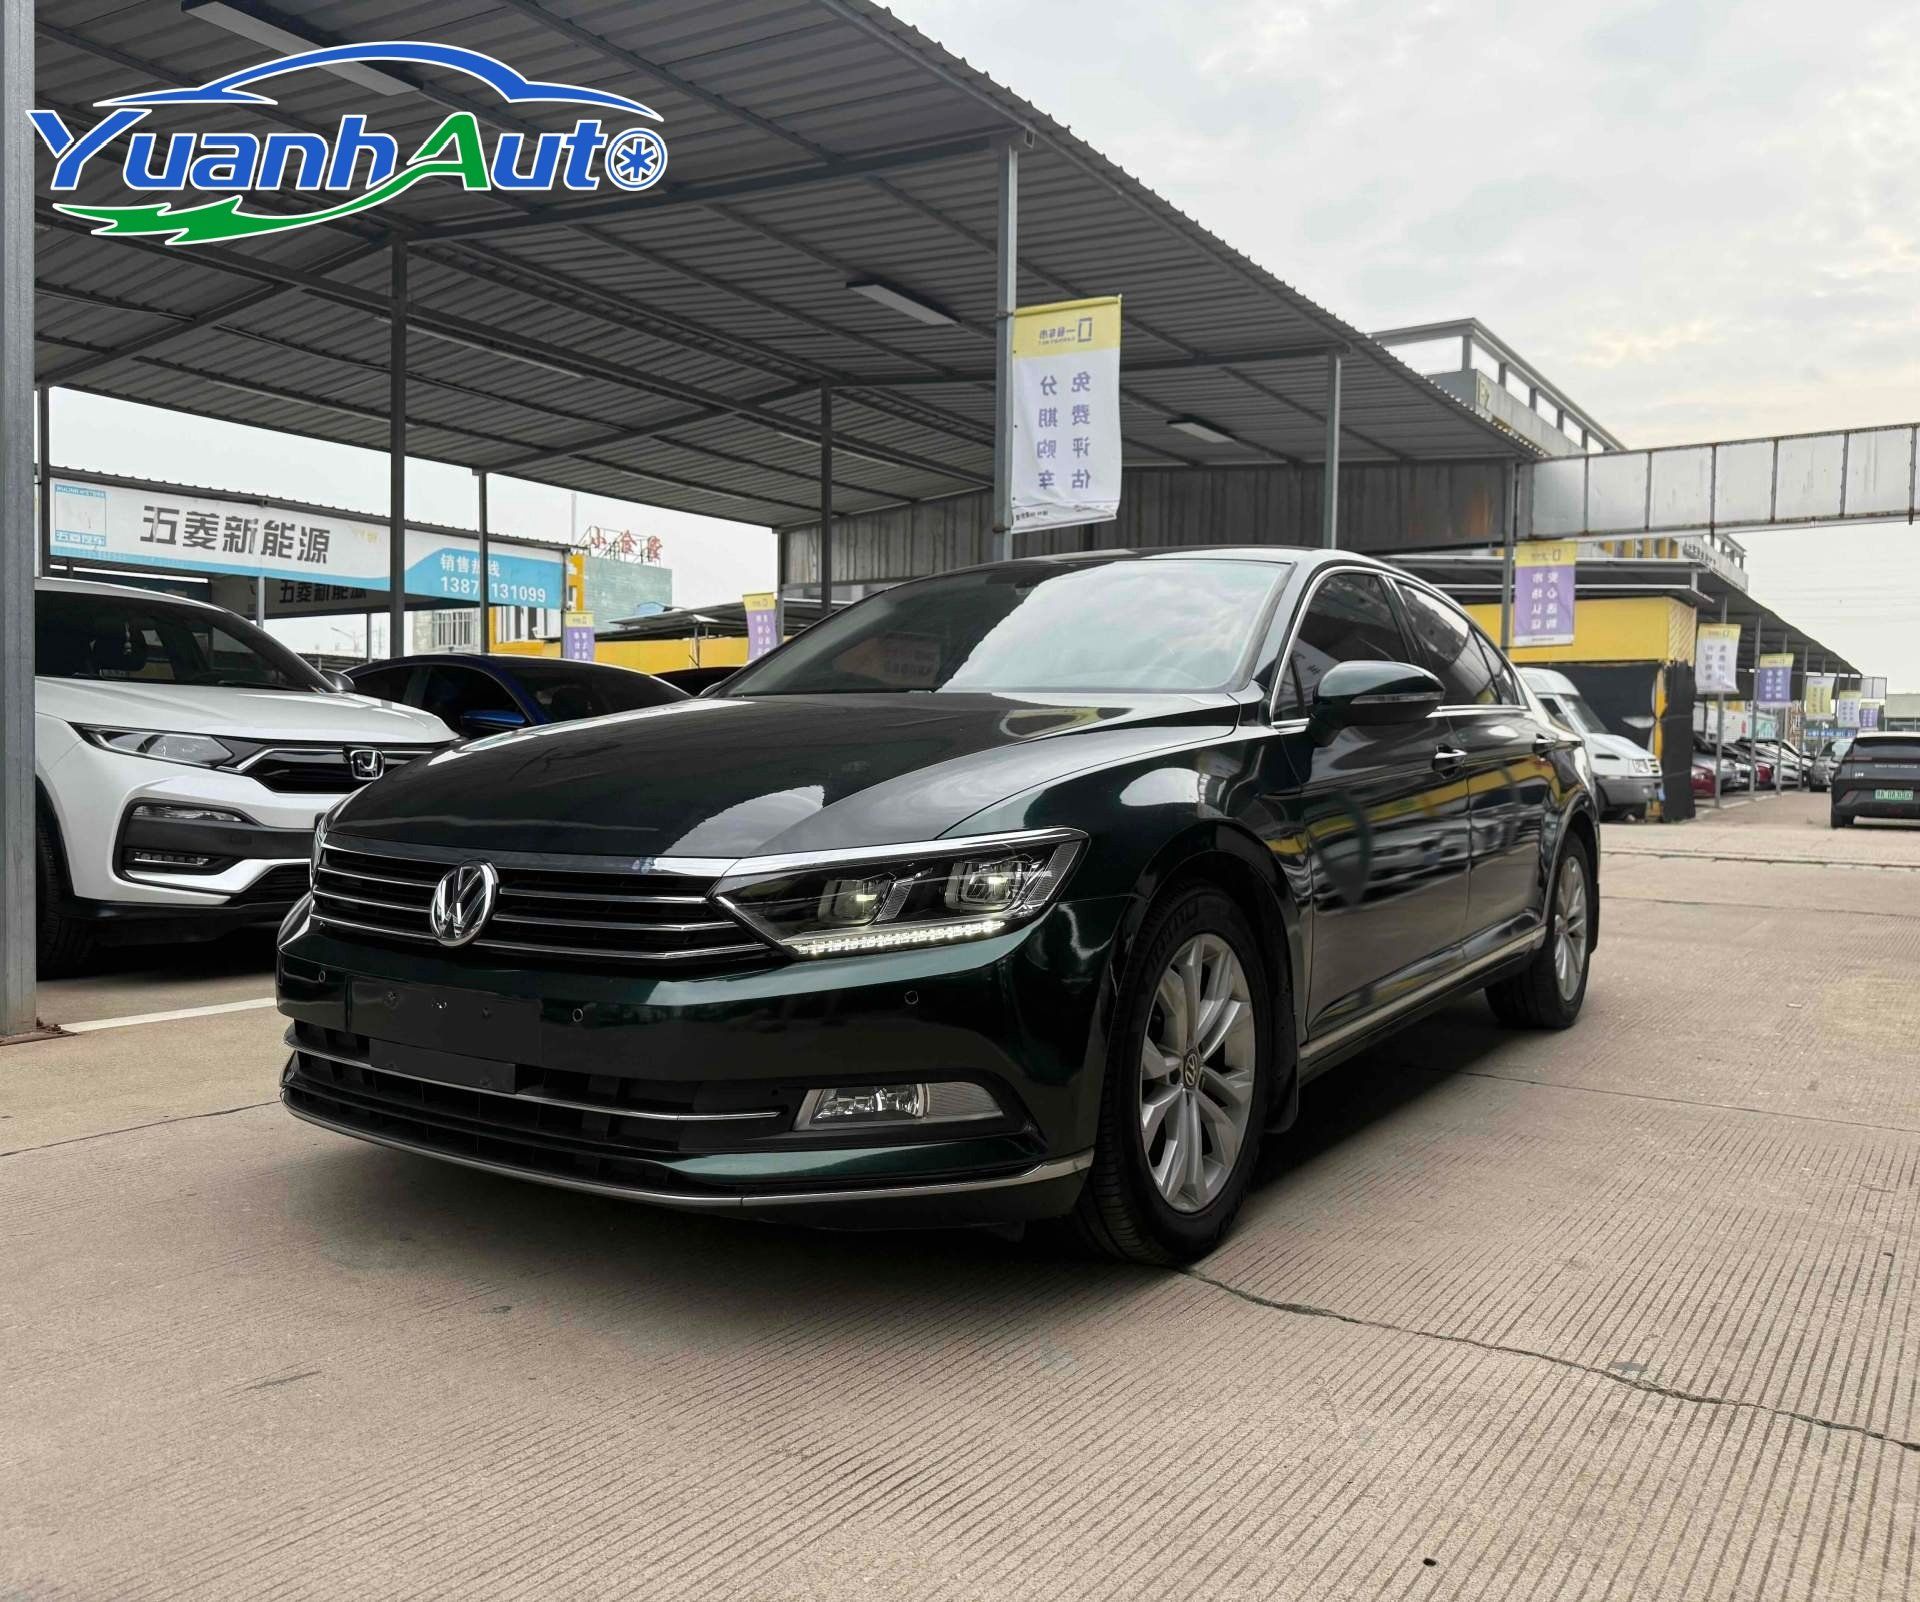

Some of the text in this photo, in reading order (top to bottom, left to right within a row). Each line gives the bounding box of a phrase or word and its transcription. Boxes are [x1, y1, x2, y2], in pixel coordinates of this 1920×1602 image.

[140, 505, 330, 564] 五菱新能源
[440, 576, 547, 603] 1387131099
